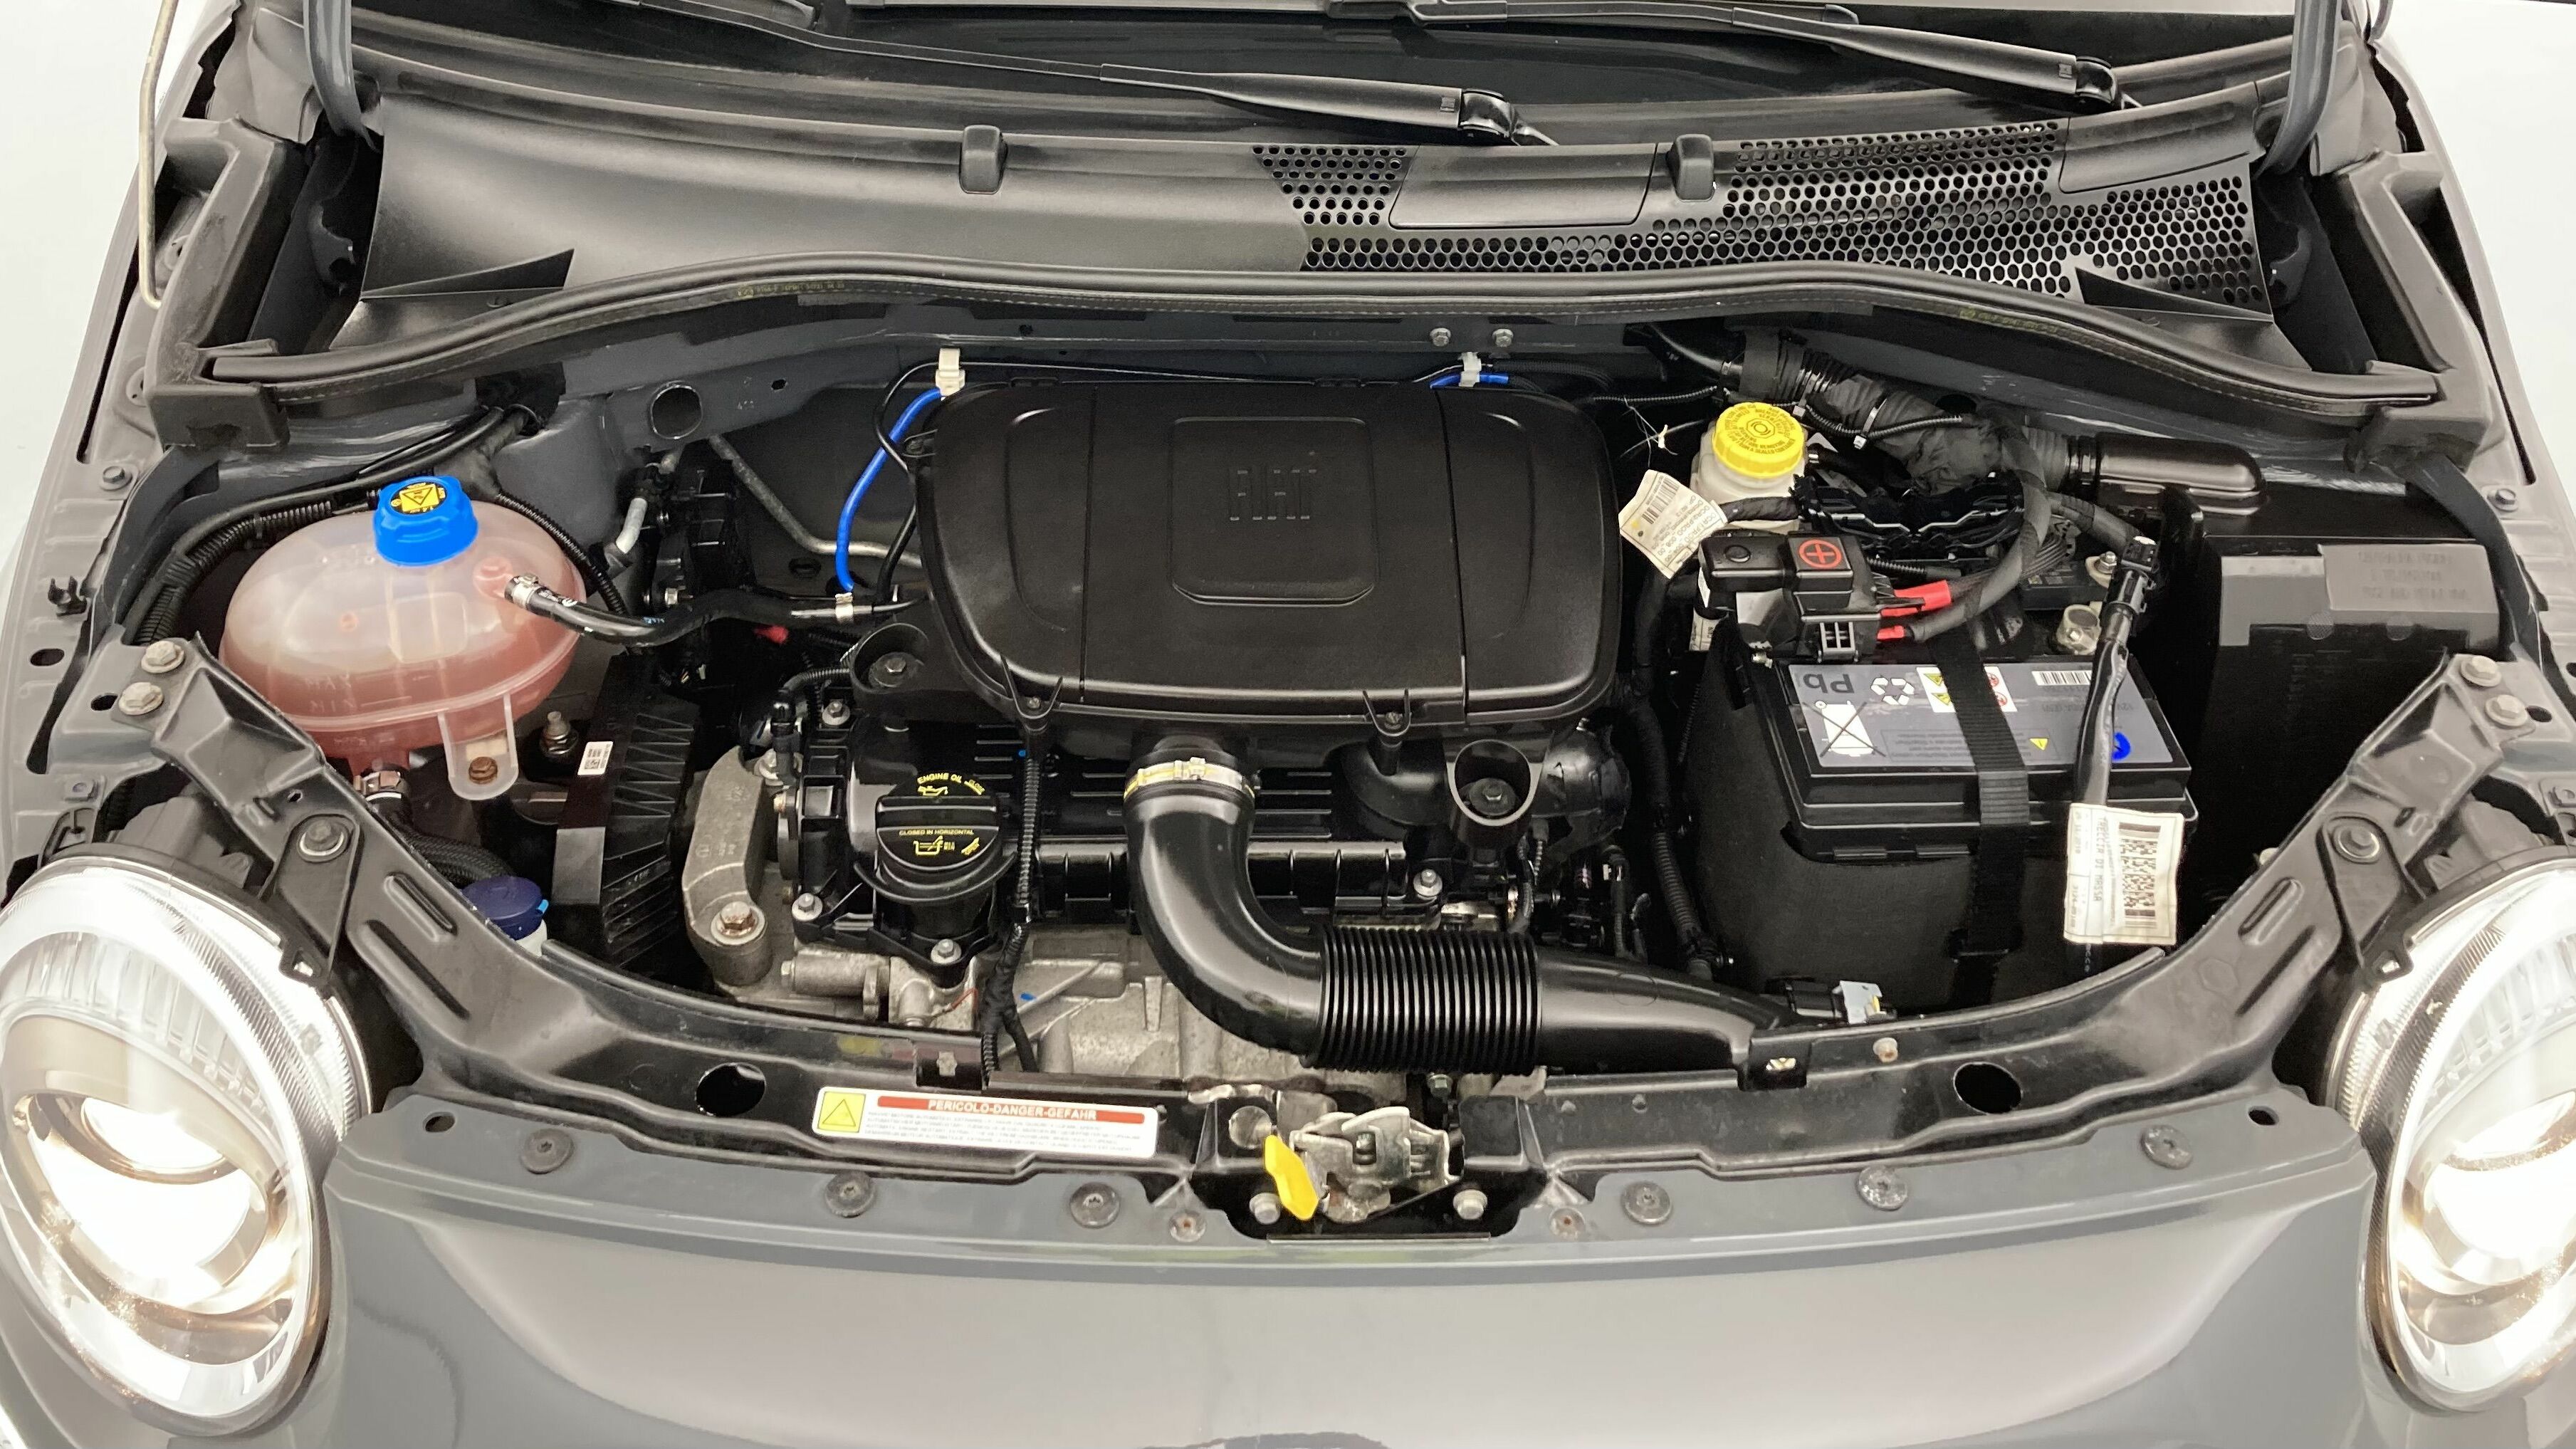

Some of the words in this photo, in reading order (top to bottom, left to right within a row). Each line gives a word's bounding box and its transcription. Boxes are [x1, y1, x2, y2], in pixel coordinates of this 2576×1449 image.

[1803, 674, 1853, 694] Pb
[917, 773, 949, 784] ENGINE
[950, 774, 962, 784] OIL
[2094, 857, 2104, 869] DI
[2093, 874, 2104, 902] MASSA
[927, 1099, 1097, 1121] PERICOLO-DANGER-GEFAHR
